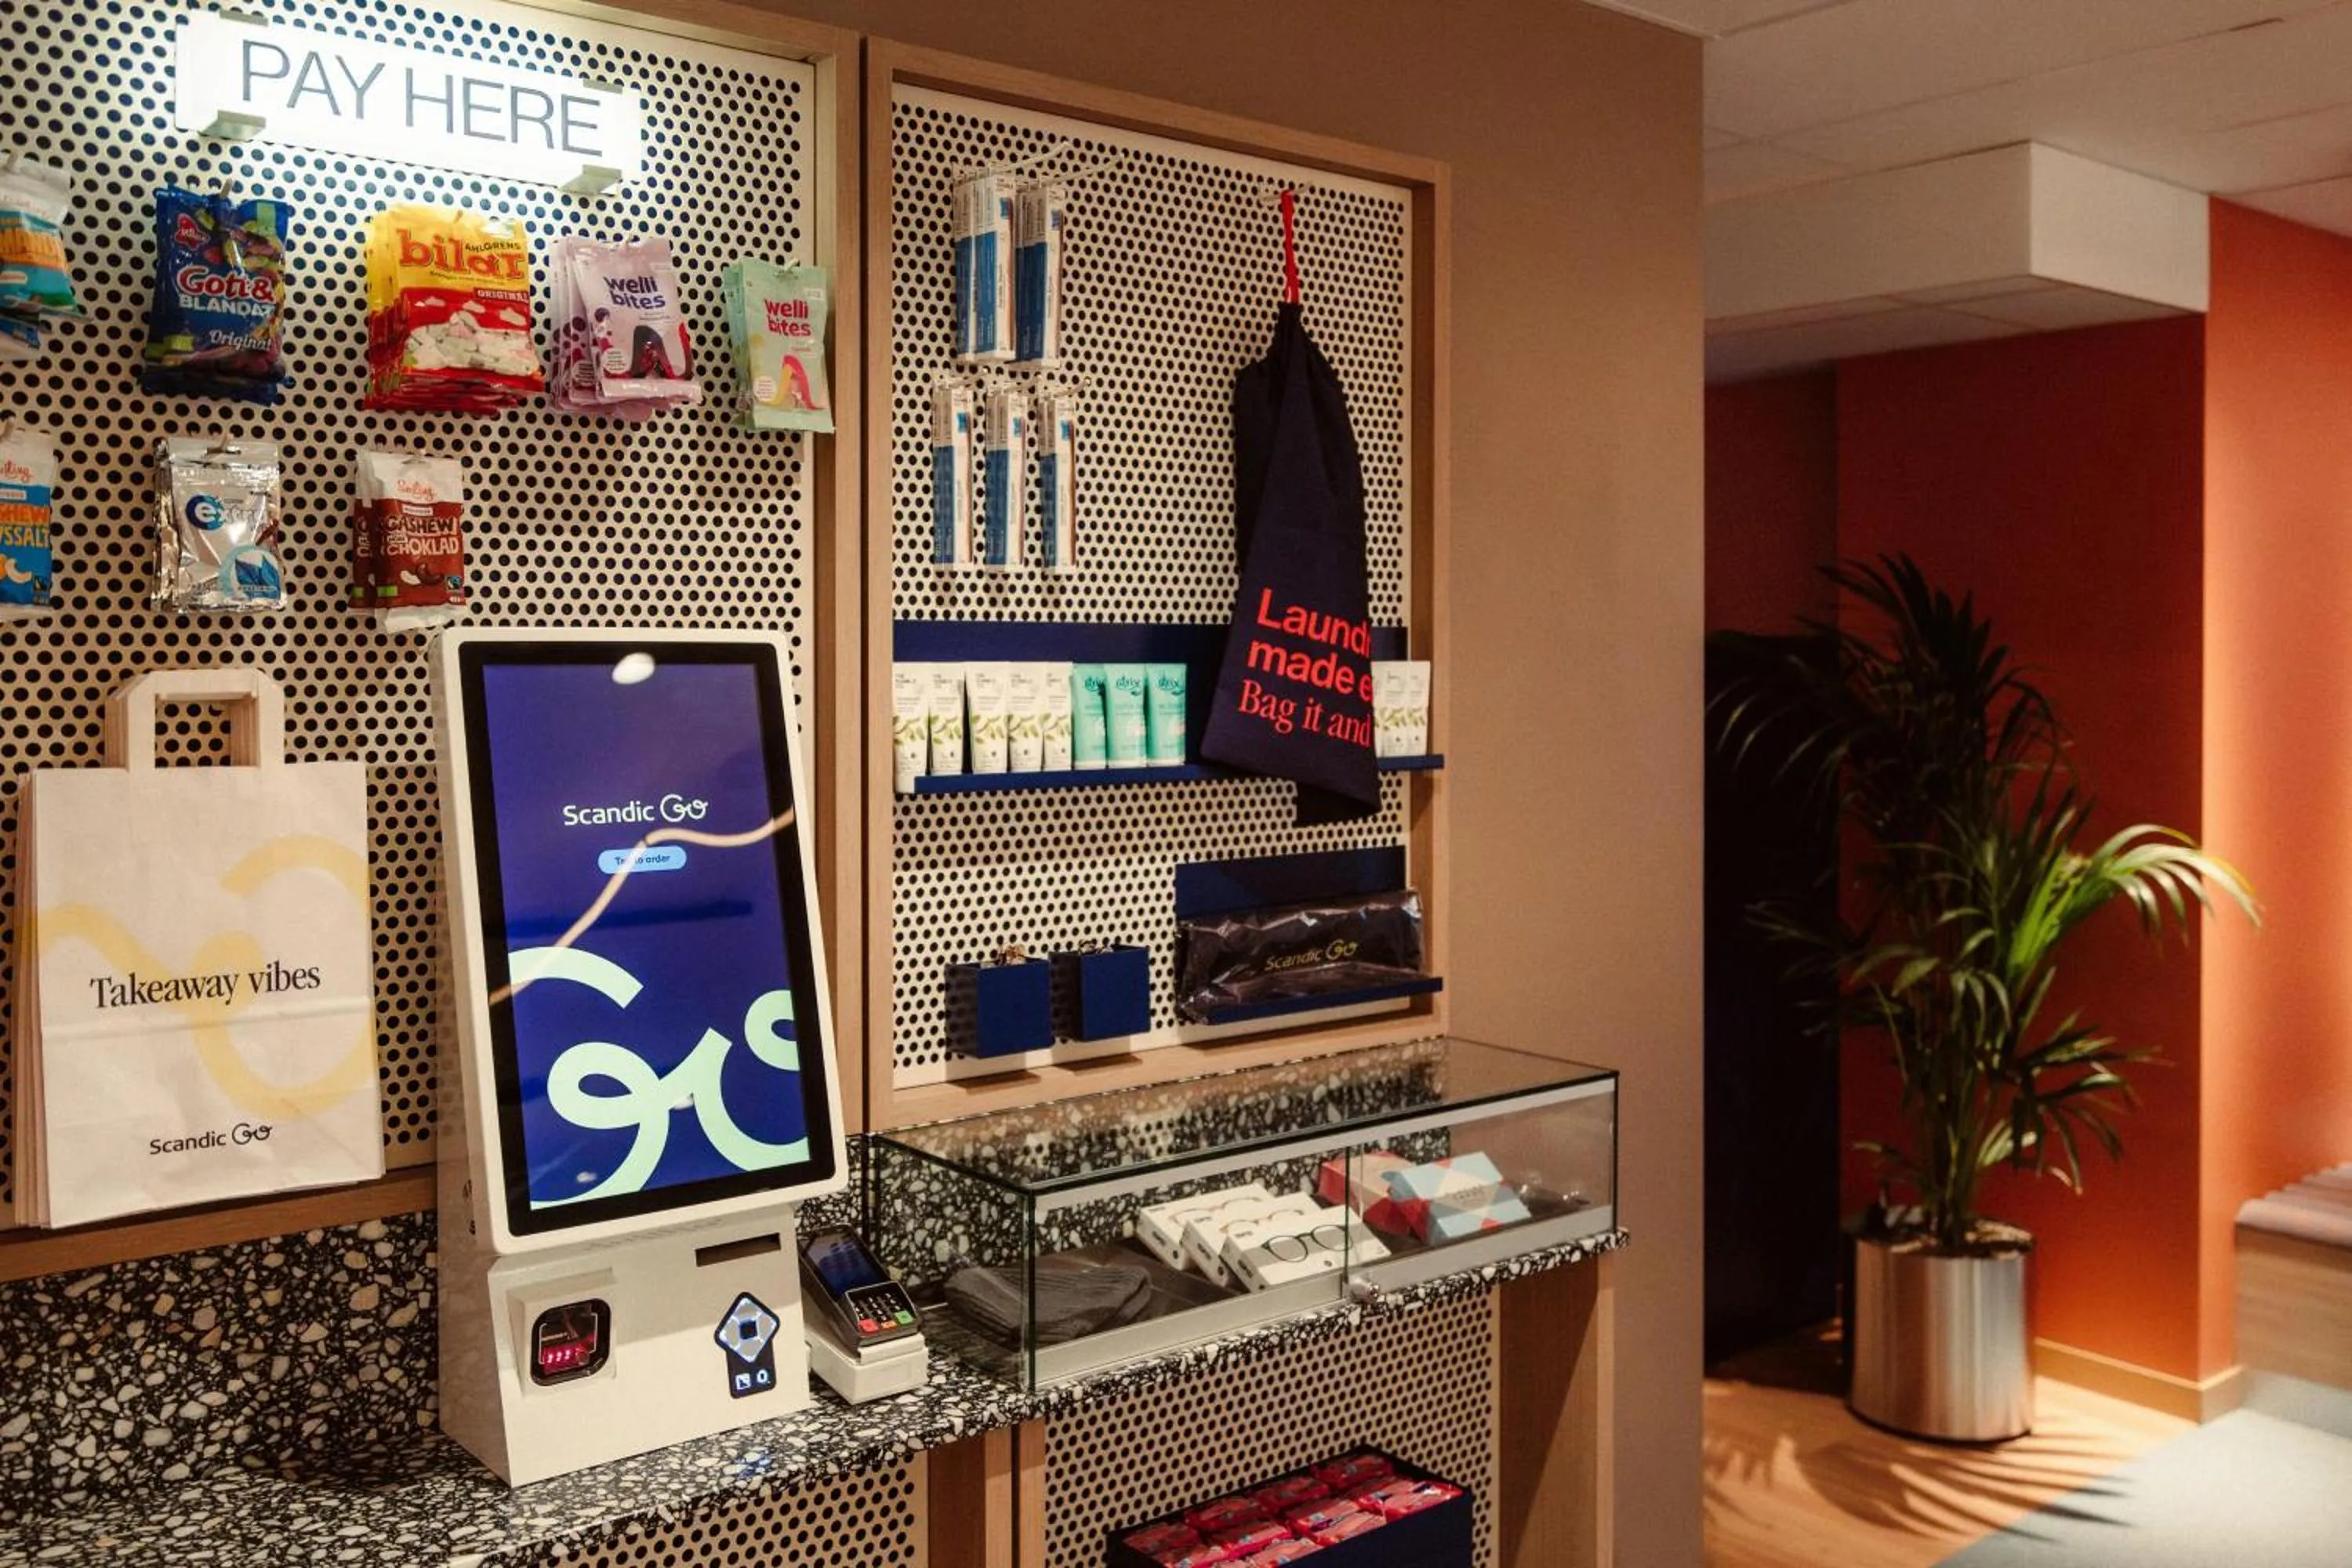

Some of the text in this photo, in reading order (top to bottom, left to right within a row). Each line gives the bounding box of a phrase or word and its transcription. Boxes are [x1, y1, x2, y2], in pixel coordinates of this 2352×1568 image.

[241, 38, 604, 158] PAY HERE
[396, 228, 525, 280] bilar
[465, 241, 521, 253] AHLGRENS
[603, 275, 659, 295] welli
[610, 290, 666, 310] bites
[763, 298, 809, 320] welli
[767, 314, 812, 337] bites
[386, 514, 456, 535] CASHEW
[387, 536, 459, 556] CHOKLAD
[1247, 639, 1355, 695] made
[1238, 678, 1371, 747] Bag it and
[562, 793, 709, 826] Scandic Go
[645, 854, 670, 863] order
[1265, 939, 1358, 971] Scandic Go
[90, 960, 321, 1009] Takeaway vibes
[149, 1123, 274, 1155] Scandic Go
